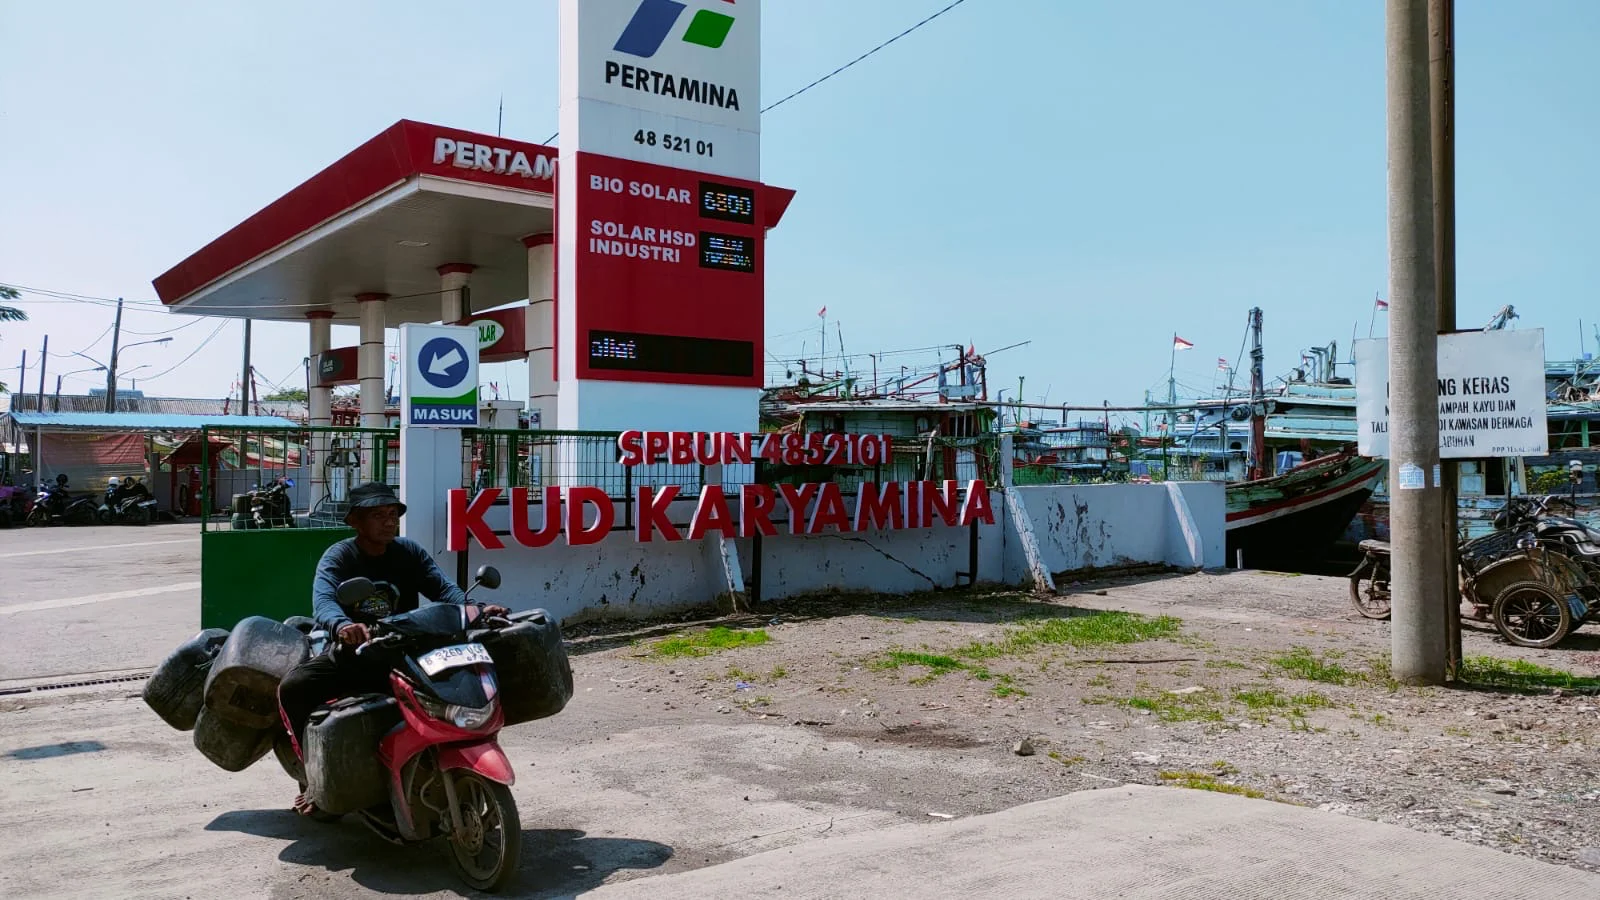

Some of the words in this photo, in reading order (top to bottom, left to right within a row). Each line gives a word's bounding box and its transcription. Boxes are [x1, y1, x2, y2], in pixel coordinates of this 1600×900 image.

[605, 61, 740, 111] PERTAMINA
[634, 129, 657, 147] 48
[663, 134, 691, 153] 521
[696, 140, 714, 157] 01
[590, 174, 624, 194] BIO
[629, 181, 691, 204] SOLAR
[591, 220, 656, 243] SOLAR
[659, 228, 696, 247] HSD
[589, 238, 681, 263] INDUSTRI
[478, 324, 496, 343] OLAR
[1462, 376, 1511, 396] KERAS
[413, 408, 474, 421] MASUK
[1439, 401, 1469, 414] AMPAH
[1472, 400, 1496, 413] KAYU
[1498, 400, 1516, 412] DAN
[1448, 417, 1489, 431] KAWASAN
[1491, 416, 1533, 430] DERMAGA
[618, 430, 752, 467] SPBUN
[760, 432, 893, 466] 4852101
[447, 486, 615, 551] KUD
[635, 479, 995, 543] KARYAMINA
